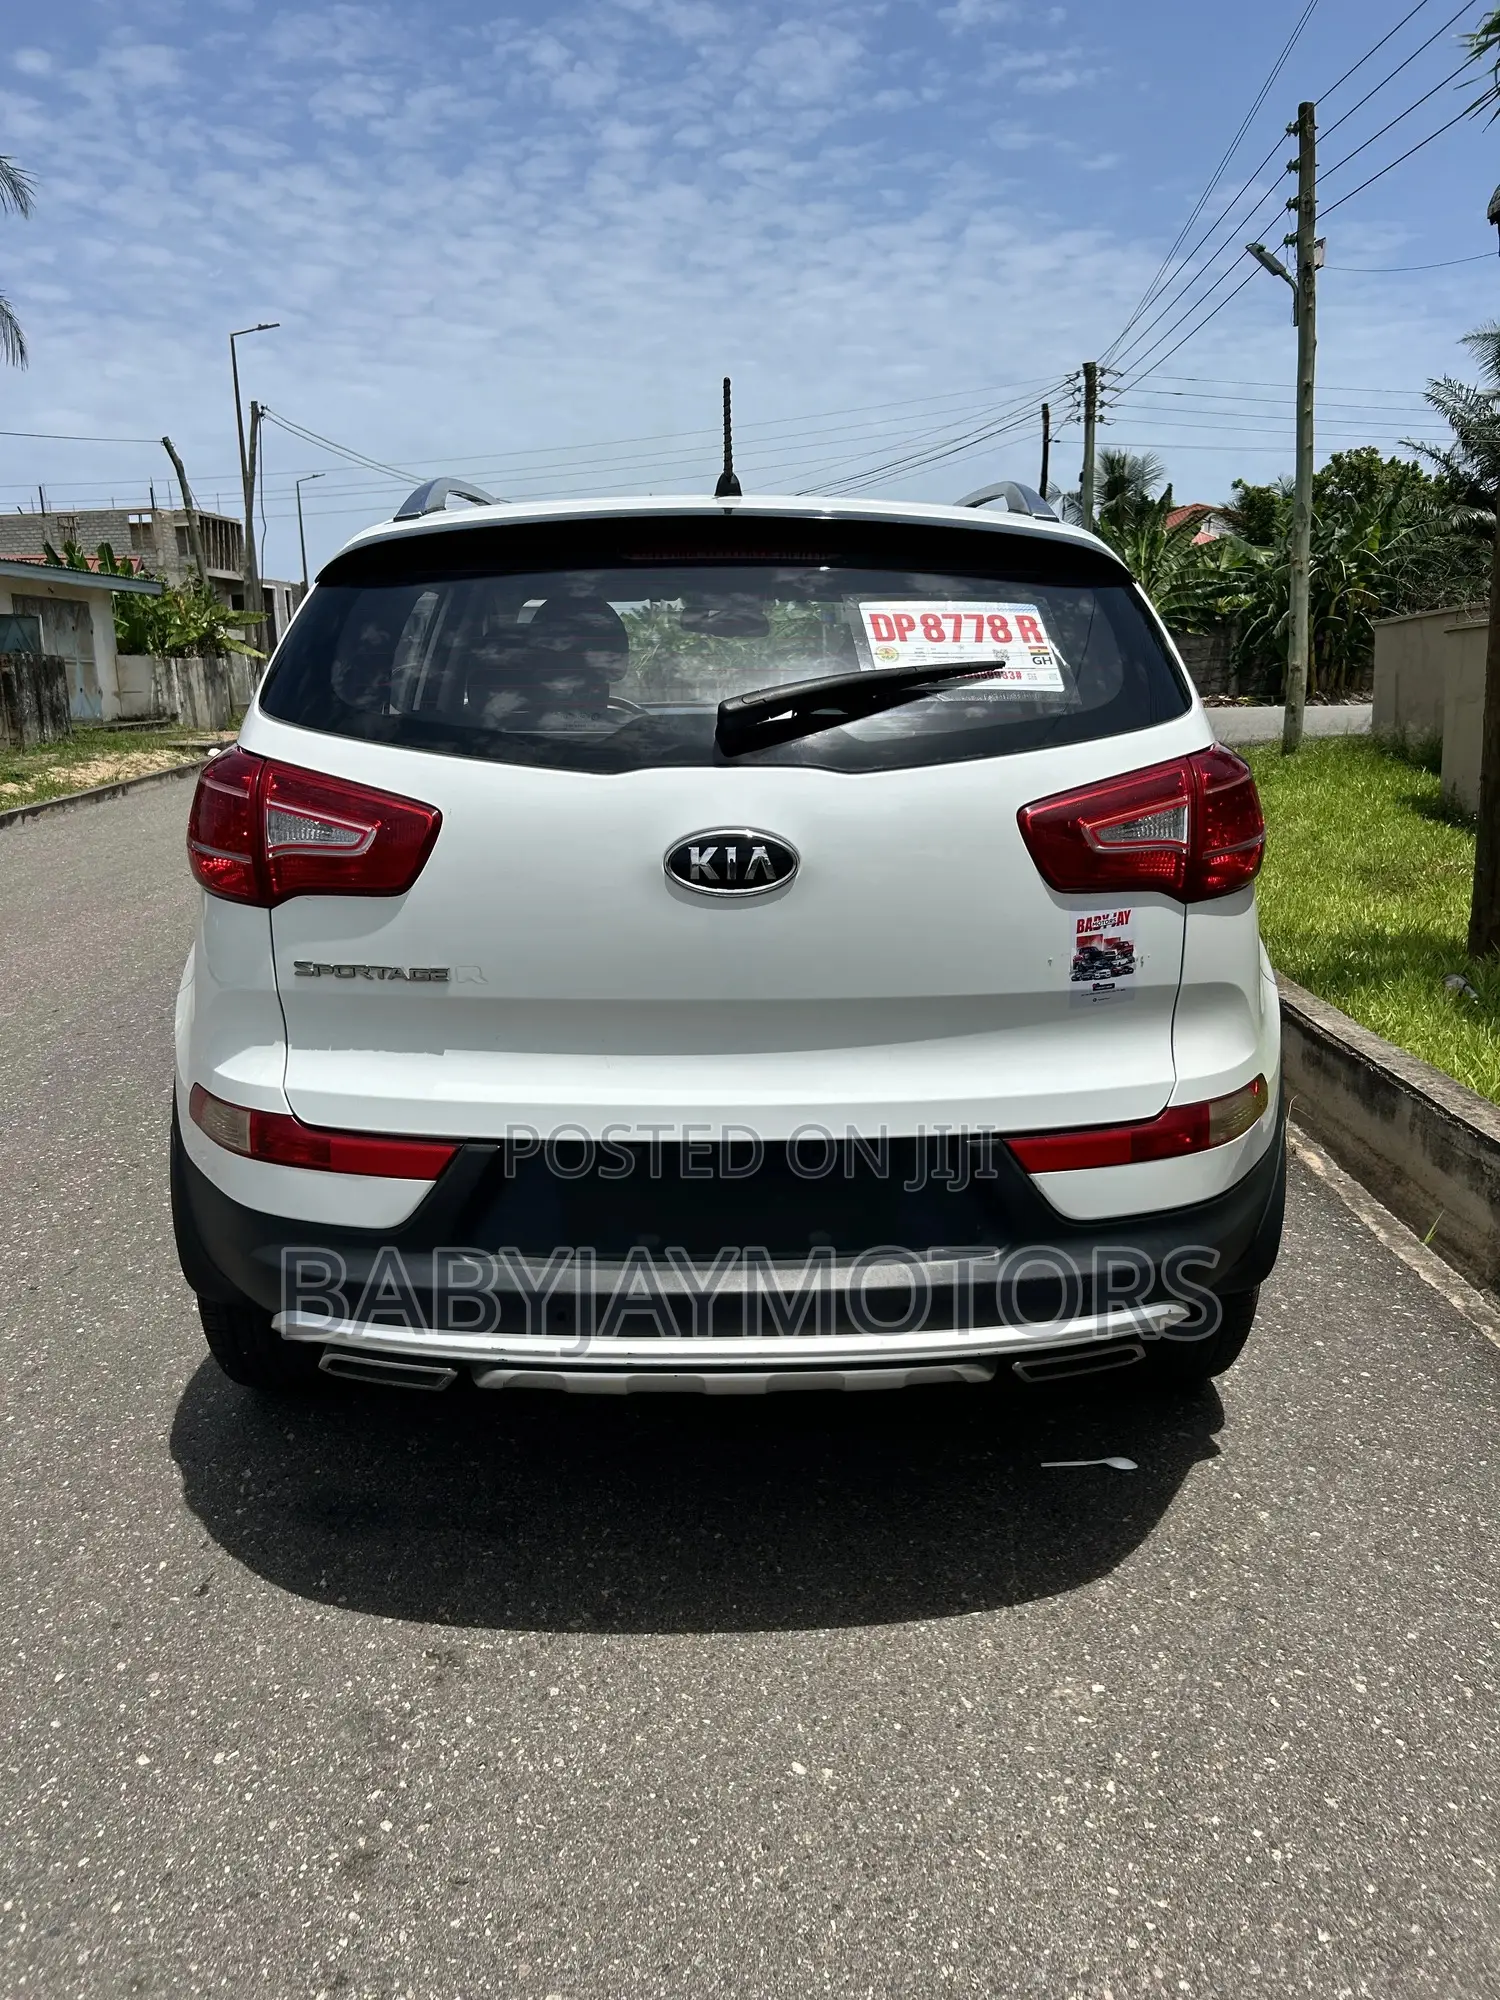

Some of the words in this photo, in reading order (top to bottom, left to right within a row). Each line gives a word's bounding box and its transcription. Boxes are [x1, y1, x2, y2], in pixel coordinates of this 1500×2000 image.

[868, 613, 916, 642] DP
[920, 613, 1013, 644] 8778
[1015, 615, 1044, 644] R
[1032, 656, 1053, 665] GH
[687, 846, 777, 880] KIA
[293, 960, 451, 982] SPORTAGE
